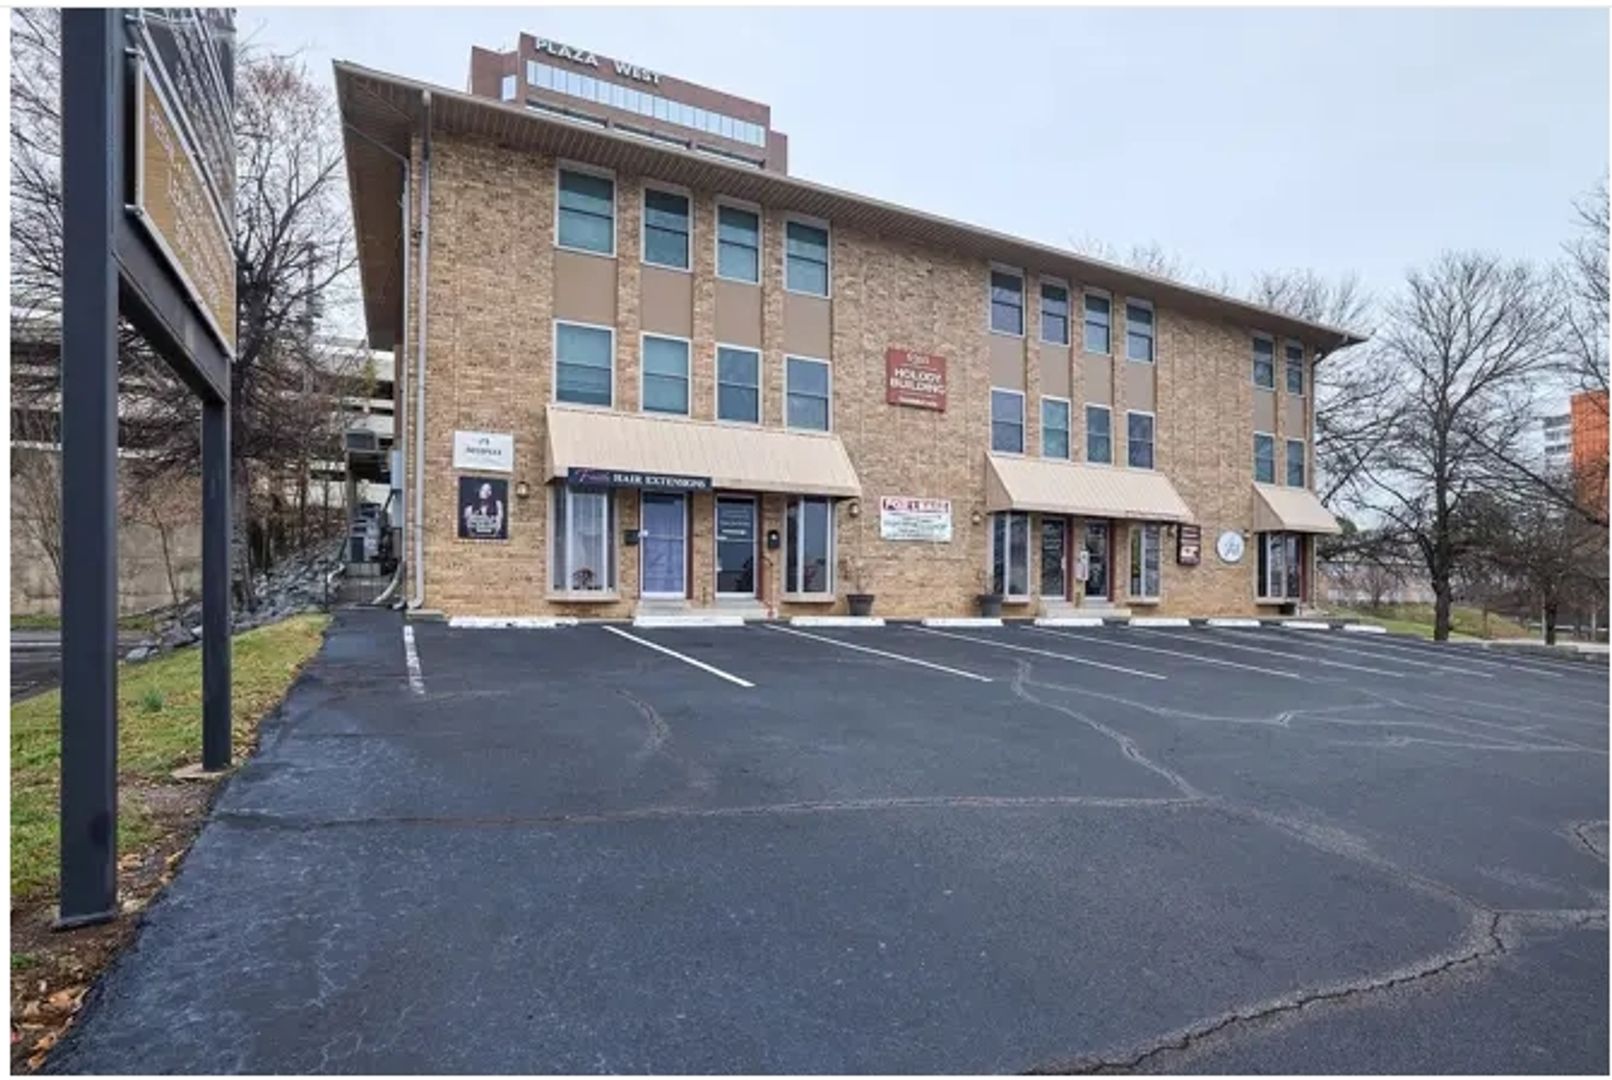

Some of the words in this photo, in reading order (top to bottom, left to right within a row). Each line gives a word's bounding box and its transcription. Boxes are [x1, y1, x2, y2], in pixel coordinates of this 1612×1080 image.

[535, 36, 599, 68] PLAZA
[613, 59, 660, 84] WEST
[889, 377, 946, 394] BUILDING
[613, 473, 643, 483] HAIR
[645, 475, 706, 488] EXTENSIONS
